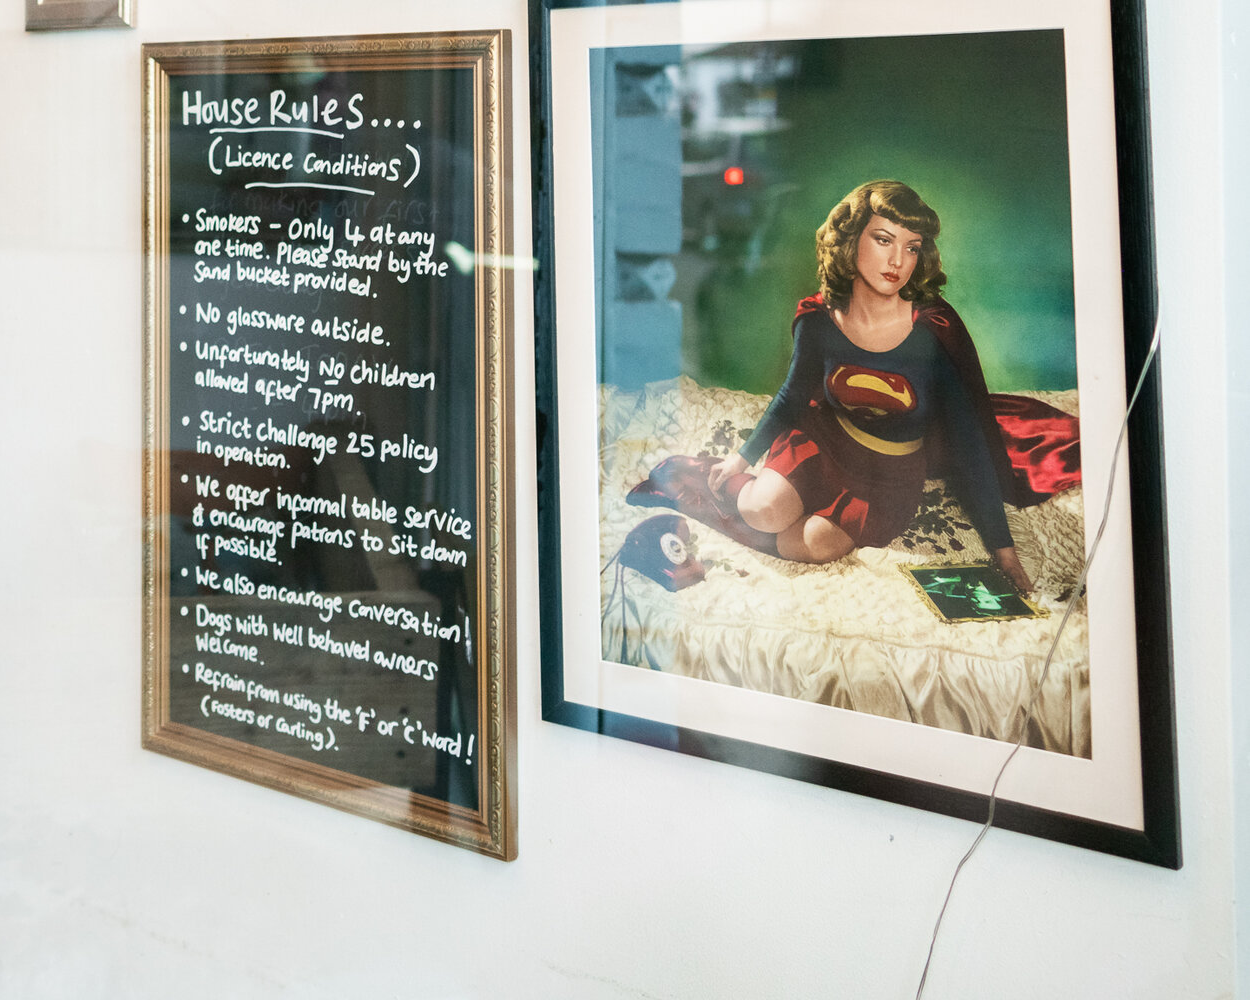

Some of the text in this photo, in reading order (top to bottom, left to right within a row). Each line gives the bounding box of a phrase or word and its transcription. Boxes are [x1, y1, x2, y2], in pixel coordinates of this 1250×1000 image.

[182, 90, 260, 125] House
[195, 208, 261, 235] Smokers
[288, 217, 334, 254] Only
[345, 219, 365, 247] 4
[370, 223, 396, 245] at
[398, 231, 435, 259] any
[195, 239, 221, 256] one
[225, 239, 270, 260] time.
[276, 241, 329, 268] Please
[388, 251, 411, 283] by
[413, 256, 449, 277] the
[237, 260, 290, 286] bucket
[293, 271, 378, 299] provided.
[195, 303, 390, 346] No glassware outside.
[196, 341, 309, 382] Unfortunately
[319, 357, 344, 379] No
[195, 371, 248, 394] allowed
[255, 378, 301, 405] after
[308, 388, 361, 415] 7pm.
[197, 437, 291, 470] in operation.
[346, 433, 374, 457] 25
[381, 434, 437, 473] policy
[196, 475, 220, 498] We
[226, 484, 270, 512] offer
[277, 486, 346, 520] informal
[352, 496, 397, 524] table
[210, 508, 284, 547] encourage
[361, 530, 383, 551] to
[420, 537, 466, 566] down
[196, 566, 220, 589] We
[223, 570, 255, 595] also
[258, 584, 342, 622] encourage
[196, 604, 231, 635] Dogs
[308, 628, 369, 661] behaved
[374, 649, 438, 681] owners
[195, 662, 244, 692] Refrain
[247, 680, 280, 705] from
[283, 693, 321, 723] using
[324, 698, 351, 724] the
[377, 720, 398, 735] or
[201, 695, 339, 751] (Fosters or Carling).
